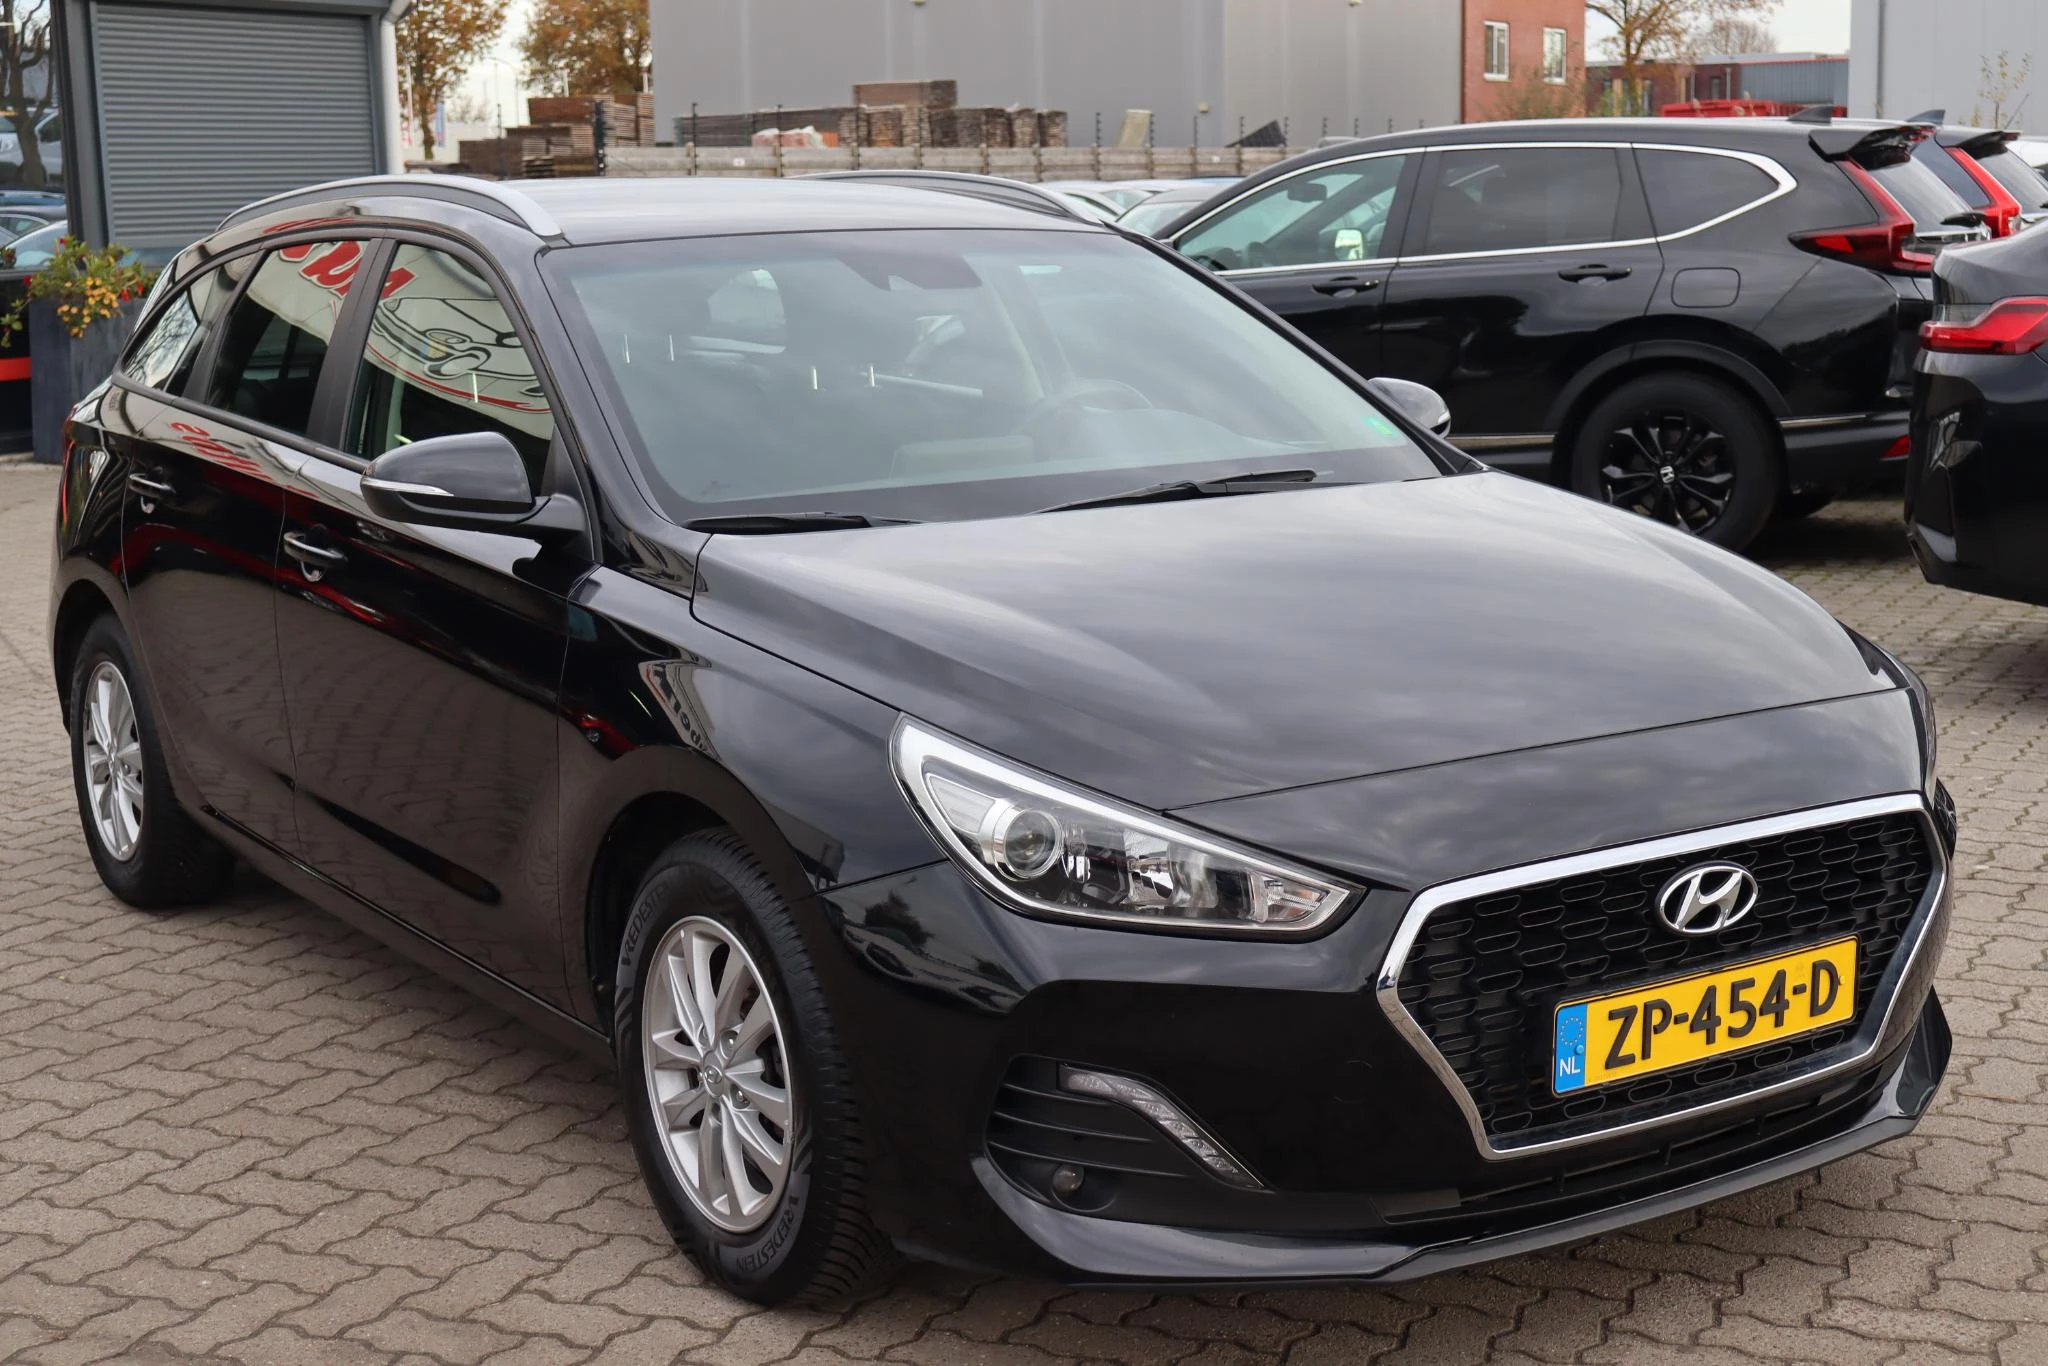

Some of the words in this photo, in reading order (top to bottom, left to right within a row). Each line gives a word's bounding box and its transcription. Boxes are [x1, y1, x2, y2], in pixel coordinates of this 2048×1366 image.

[1604, 959, 1840, 1070] ZP-454-D
[1560, 1056, 1580, 1077] NL
[736, 1195, 800, 1272] VREDESTEIN
